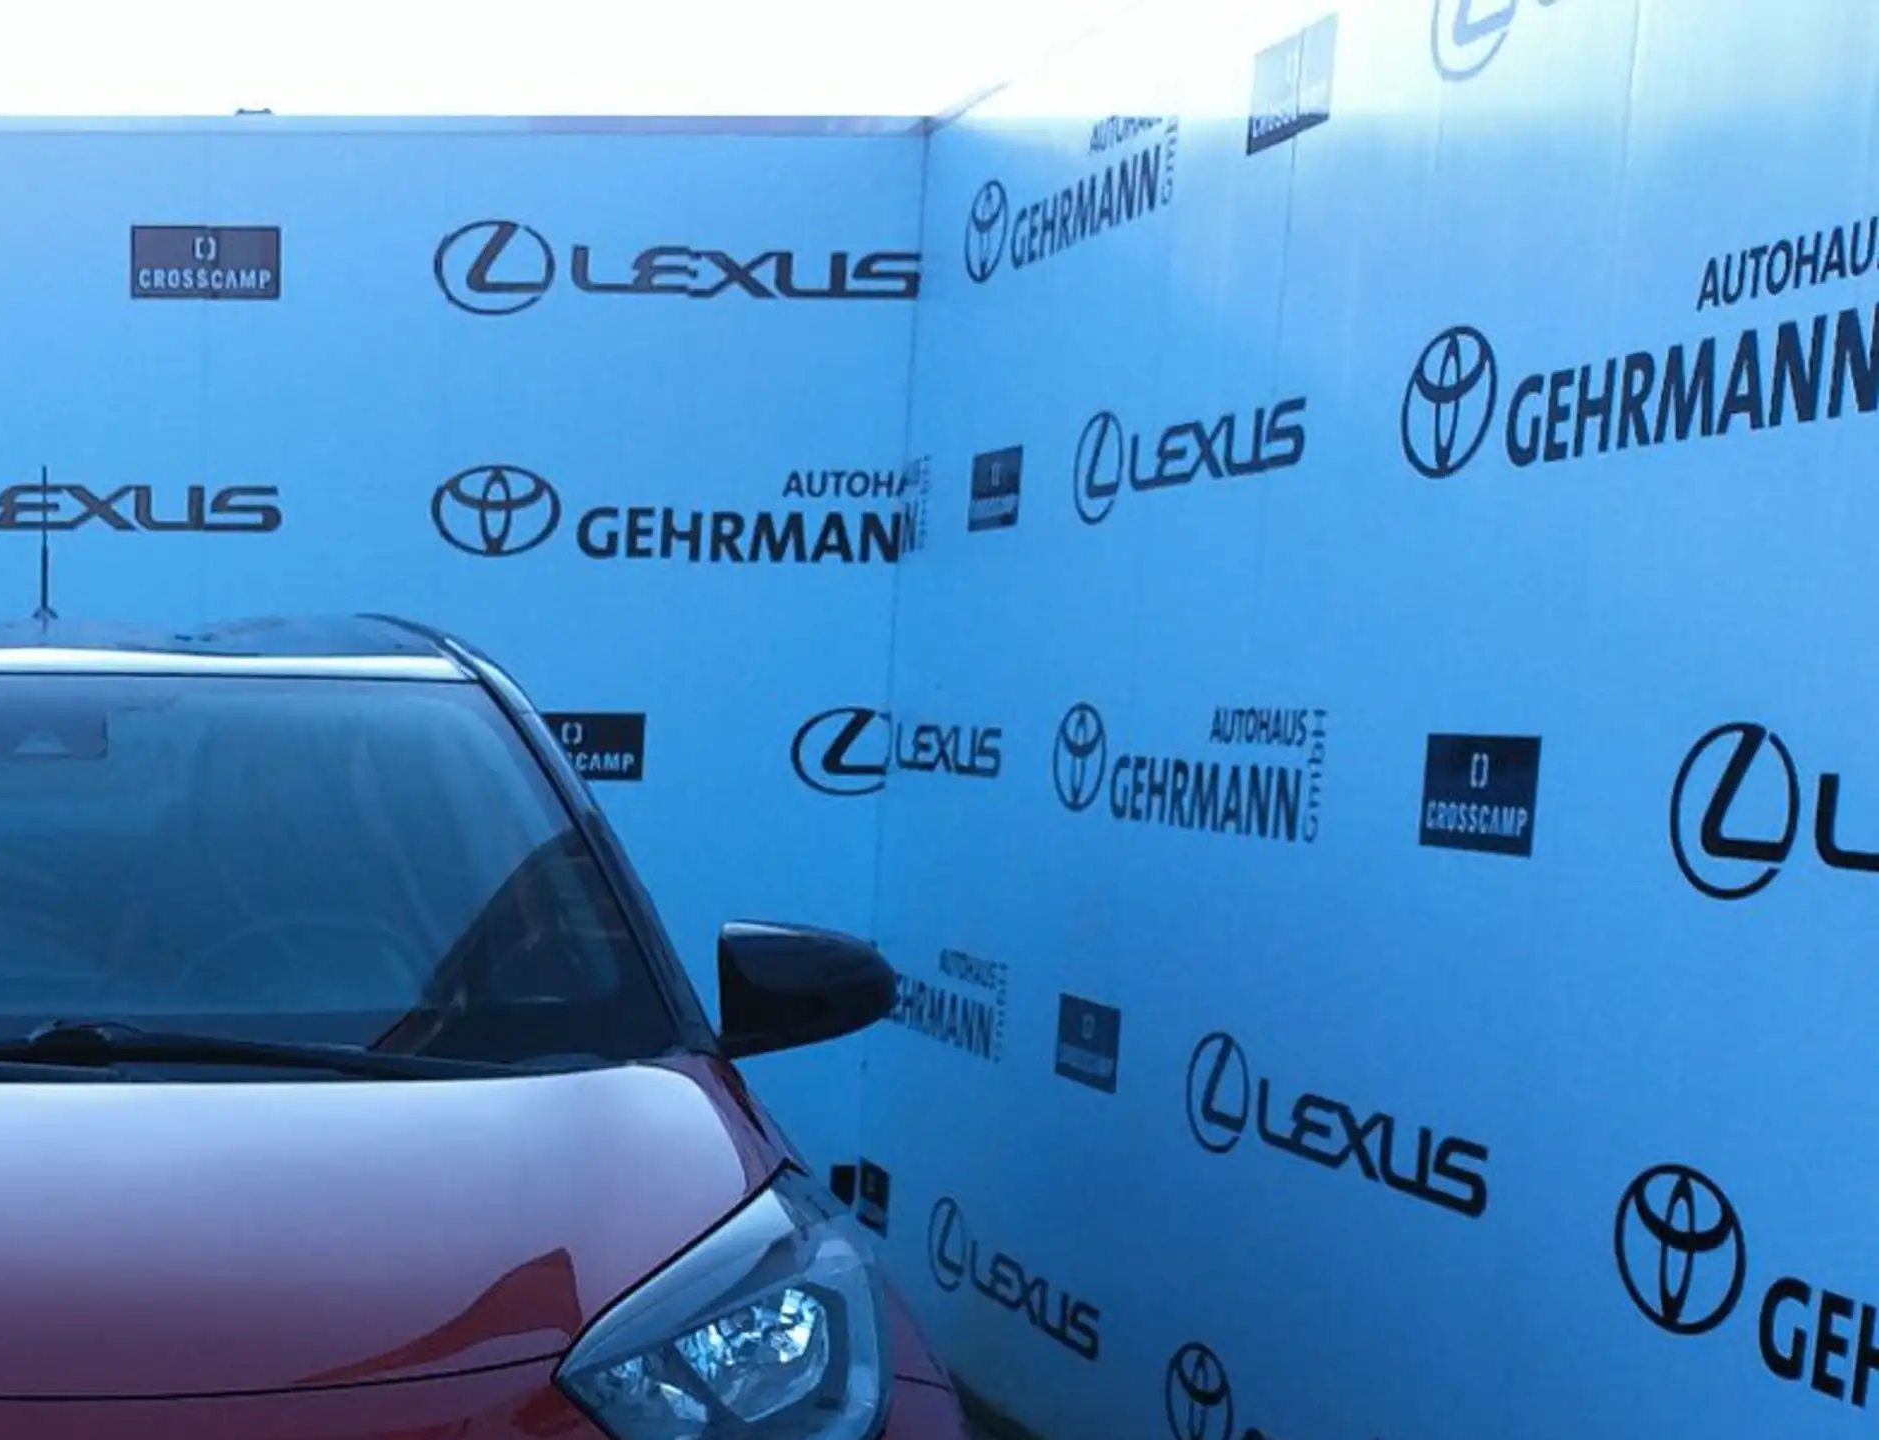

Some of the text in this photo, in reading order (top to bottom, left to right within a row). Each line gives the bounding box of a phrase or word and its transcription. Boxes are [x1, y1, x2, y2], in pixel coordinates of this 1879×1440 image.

[1010, 142, 1161, 270] GEHRMANN
[138, 268, 272, 290] CROSSCAMP
[570, 245, 923, 300] LEXUS
[1506, 301, 1879, 468] GEHRMANN
[1128, 396, 1308, 492] LEXUS
[895, 723, 1003, 779] LEXUS
[1210, 704, 1309, 748] AUTOHAUS
[1109, 753, 1302, 844] GEHRMANN
[1425, 799, 1529, 837] CROSSCAMP
[1256, 1077, 1489, 1219] LEXUS
[969, 1237, 1100, 1361] LEXUS
